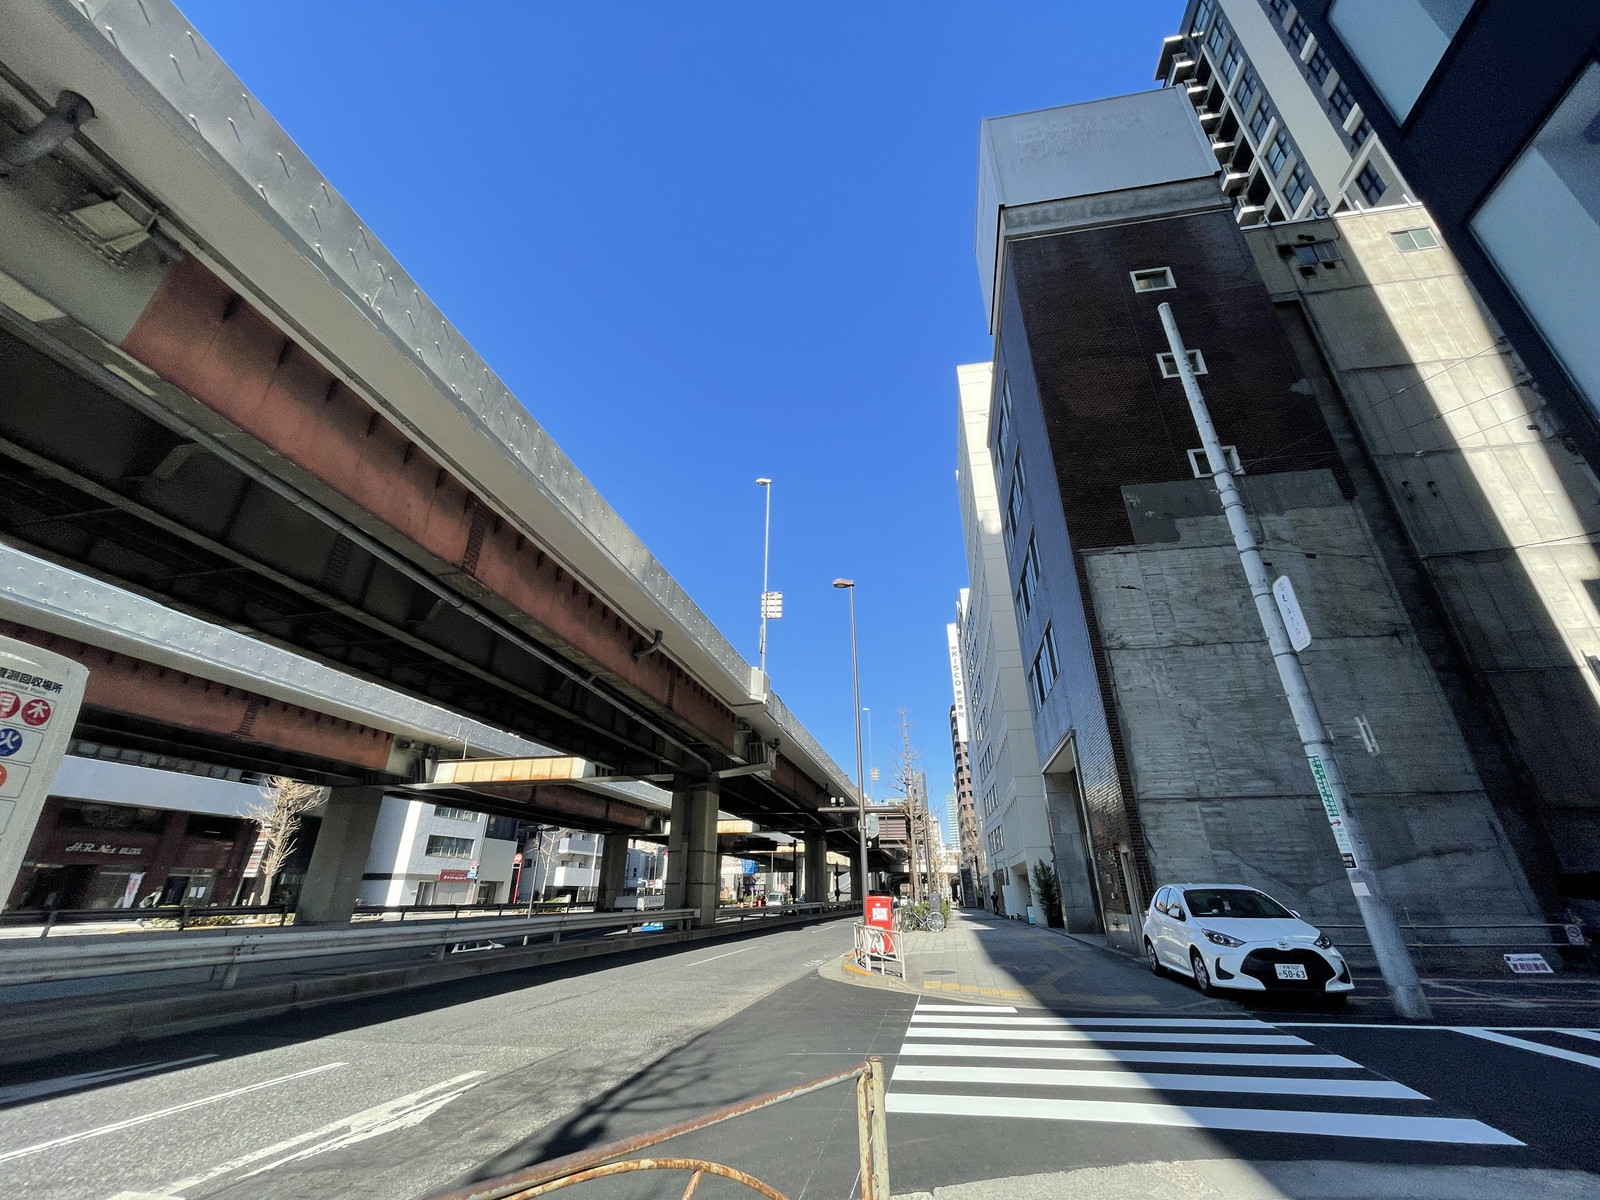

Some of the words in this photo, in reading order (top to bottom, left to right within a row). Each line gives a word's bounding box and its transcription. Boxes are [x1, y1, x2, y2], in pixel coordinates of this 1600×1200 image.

[951, 651, 962, 686] KISCO
[27, 702, 50, 719] 木
[0, 731, 20, 750] 火
